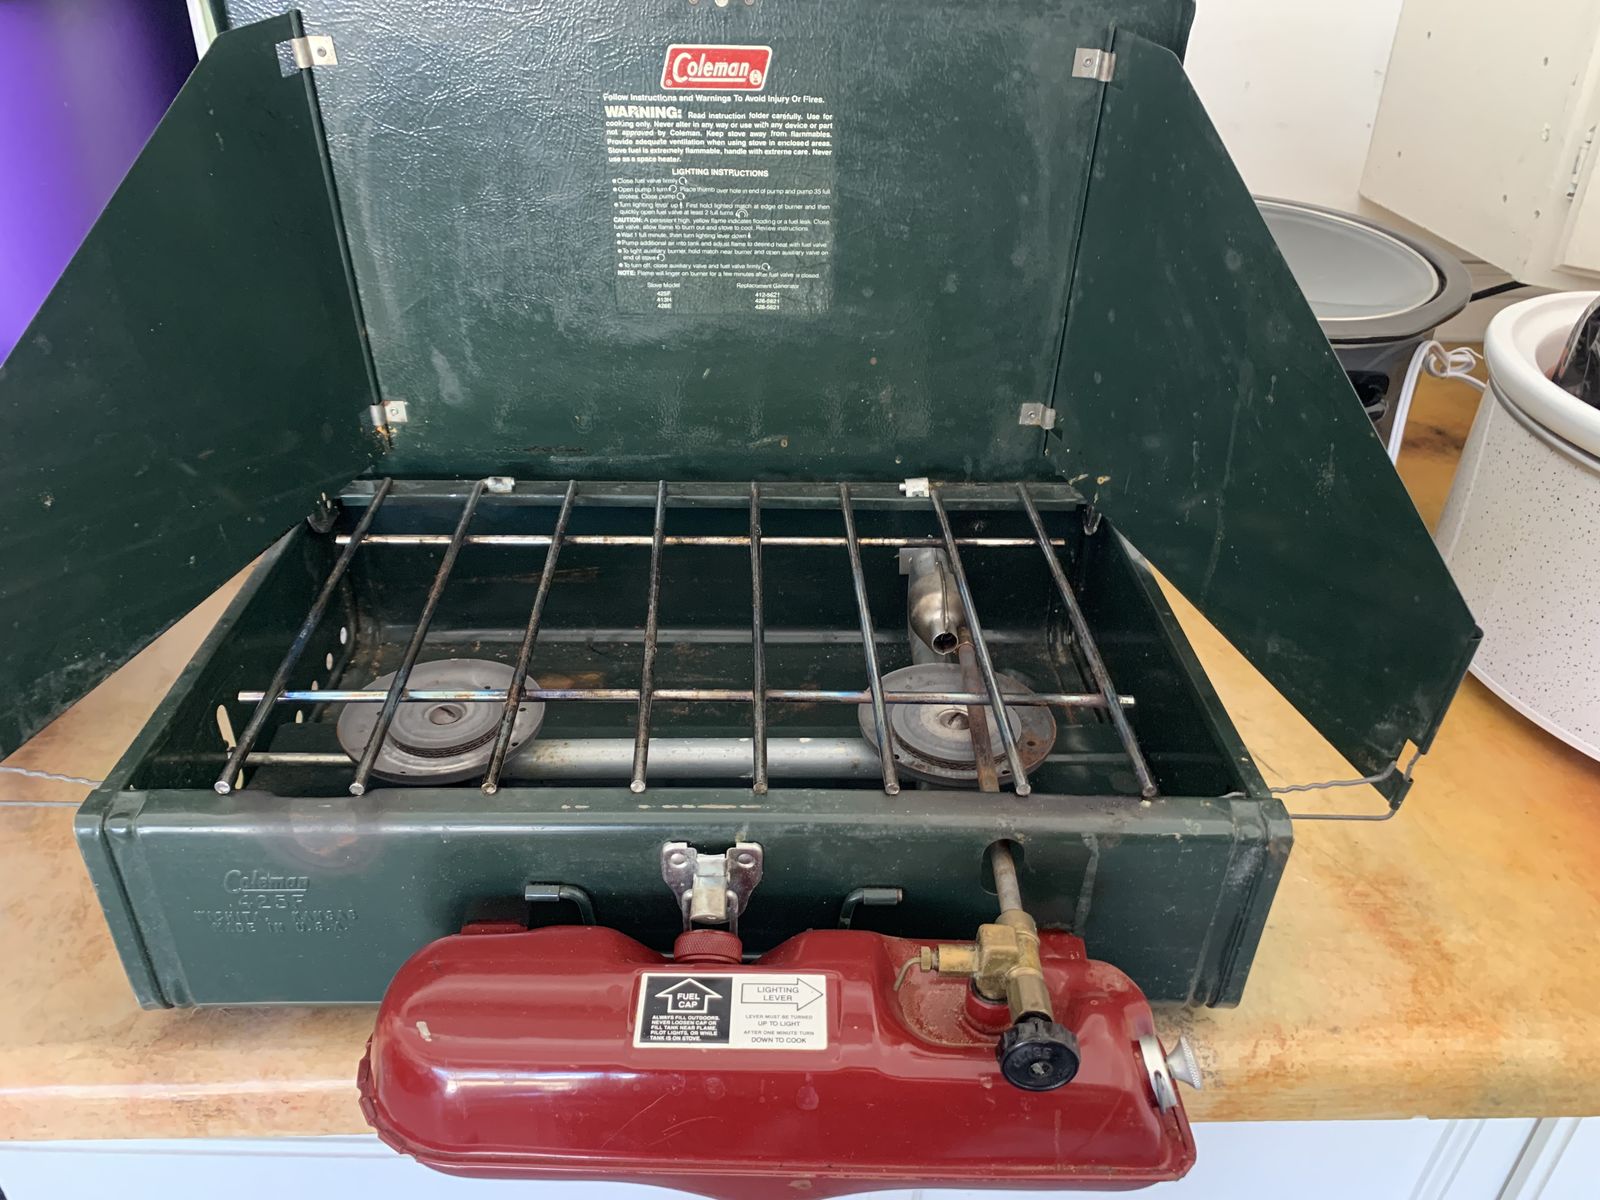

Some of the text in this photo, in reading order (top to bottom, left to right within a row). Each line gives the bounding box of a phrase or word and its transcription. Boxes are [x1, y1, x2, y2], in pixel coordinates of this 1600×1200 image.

[673, 52, 750, 82] Coleman
[695, 95, 731, 103] Warnings
[768, 95, 789, 104] Injury
[604, 106, 682, 118] WARNING:
[711, 169, 768, 177] INSTRUCTIONS
